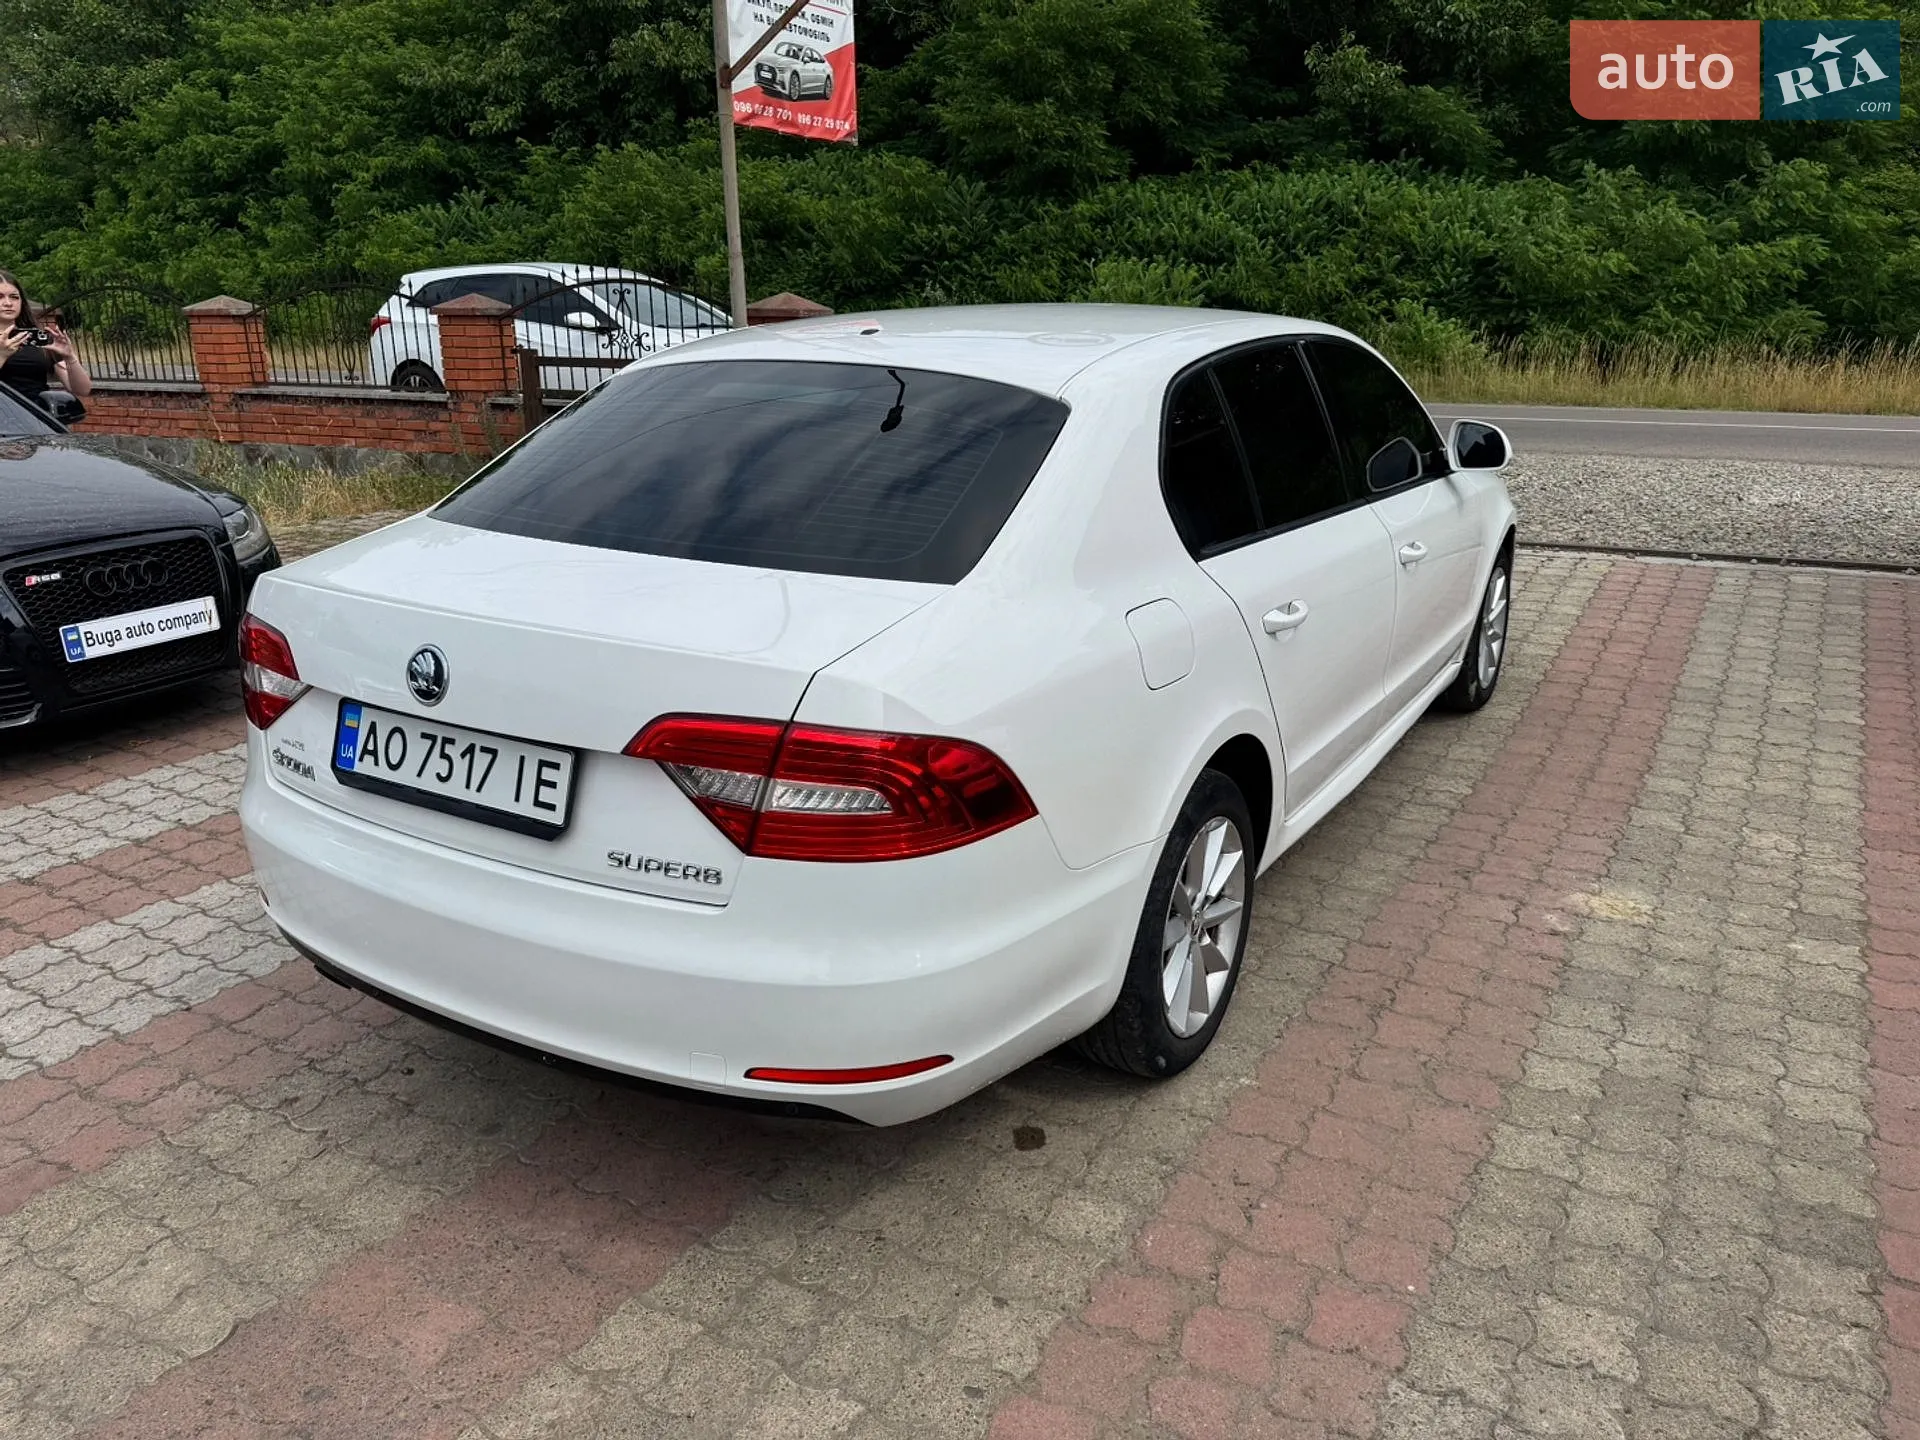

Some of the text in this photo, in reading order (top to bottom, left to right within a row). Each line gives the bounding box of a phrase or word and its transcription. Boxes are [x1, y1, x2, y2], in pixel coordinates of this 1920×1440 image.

[785, 22, 831, 42] ВТОМОБІЛЬ
[83, 609, 212, 648] Buga auto company
[341, 743, 354, 759] UA
[358, 720, 562, 813] AO 7517 IE
[607, 850, 722, 885] SUPERB
